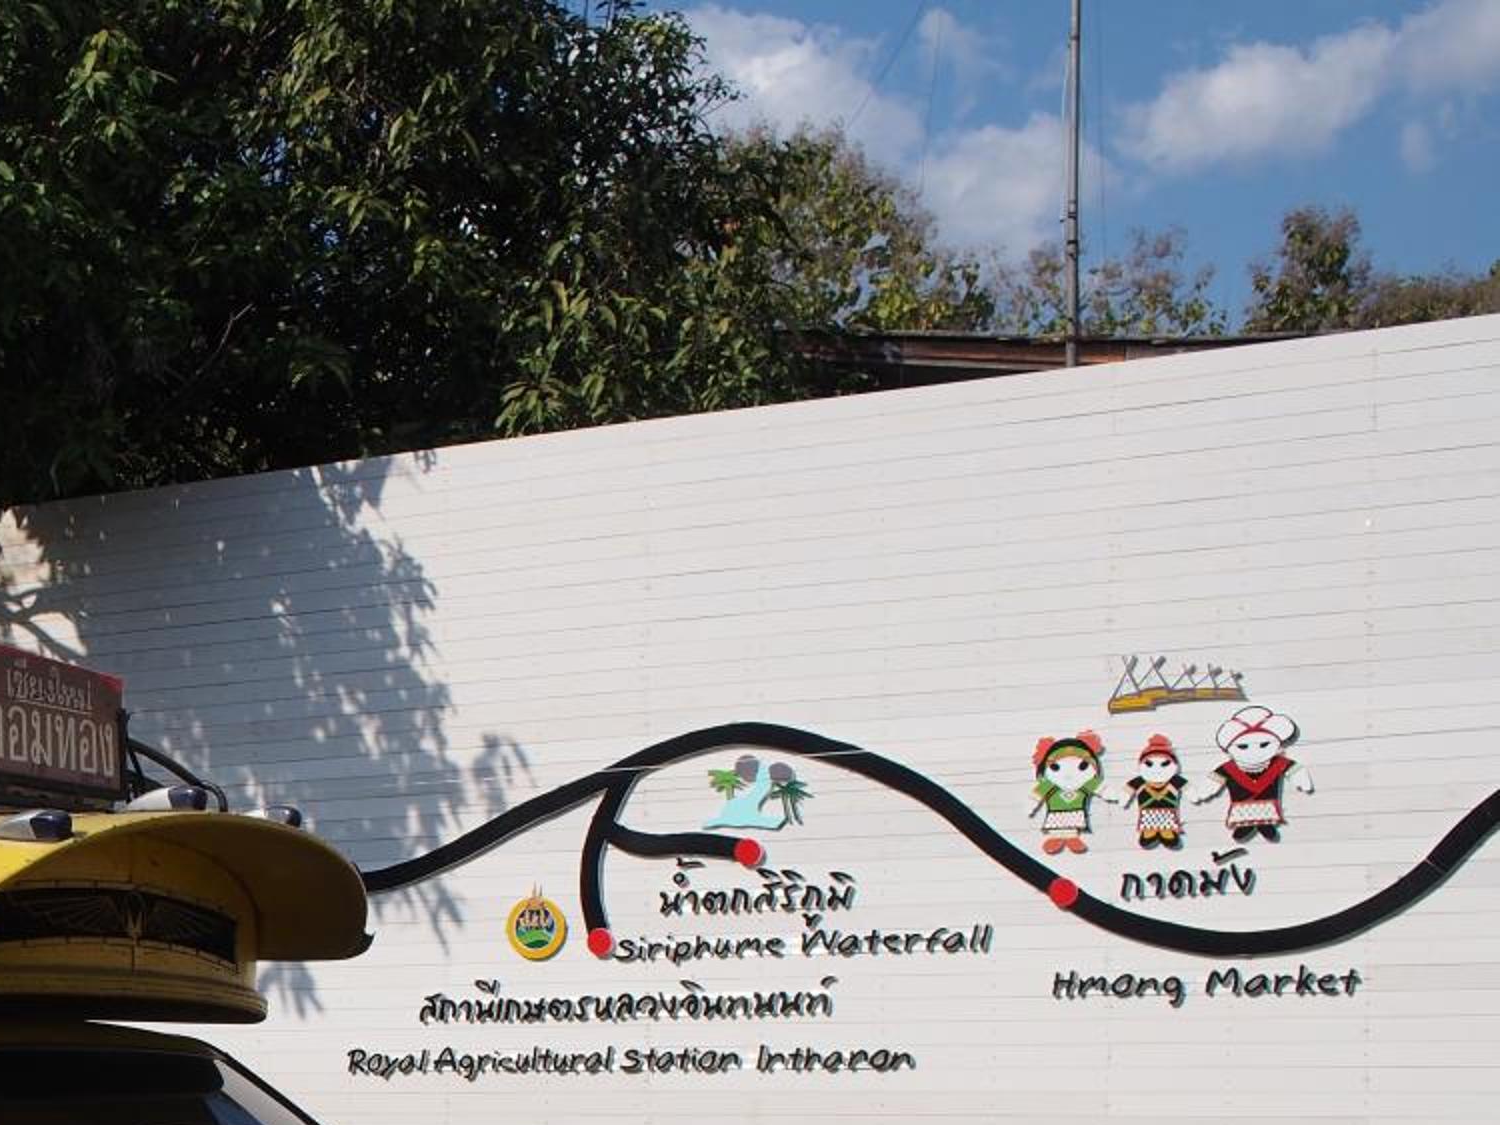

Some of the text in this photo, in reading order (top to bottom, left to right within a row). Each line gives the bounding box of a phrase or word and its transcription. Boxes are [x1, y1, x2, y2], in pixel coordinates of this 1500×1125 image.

[1121, 847, 1257, 900] กาดม้ง
[613, 924, 994, 966] Siriphume Waterfall
[419, 976, 838, 1025] สถานีเกษตรหลวงอินทนนท์
[1052, 965, 1363, 1008] Hmong Market
[347, 1048, 429, 1081] Royal
[433, 1046, 616, 1083] Agricultural
[619, 1047, 743, 1075] Station
